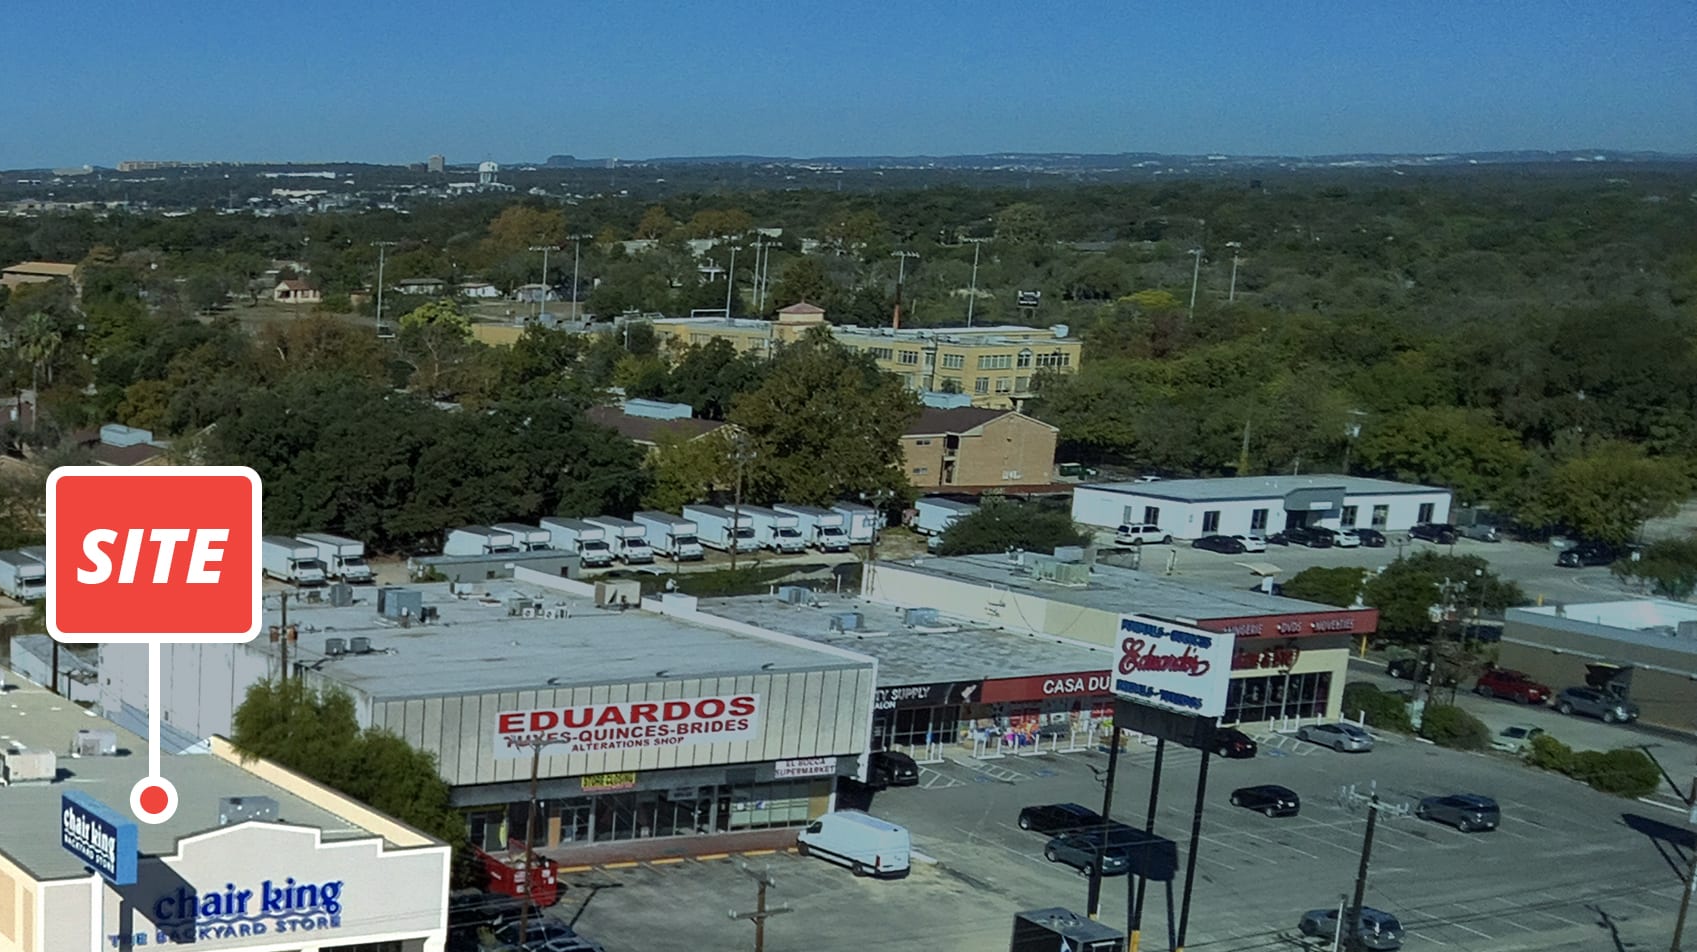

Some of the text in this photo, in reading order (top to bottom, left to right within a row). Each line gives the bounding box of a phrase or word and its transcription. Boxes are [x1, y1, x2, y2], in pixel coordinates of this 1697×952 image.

[890, 686, 931, 701] SUPPLY
[1042, 677, 1085, 695] CASA
[498, 695, 756, 735] EDUARDOS
[873, 700, 897, 710] ALON
[570, 735, 686, 753] ALTERATIONS SHOP
[63, 806, 117, 866] chair king
[153, 876, 345, 921] chair king
[155, 922, 268, 946] BACKYARD
[275, 915, 343, 934] STORE
